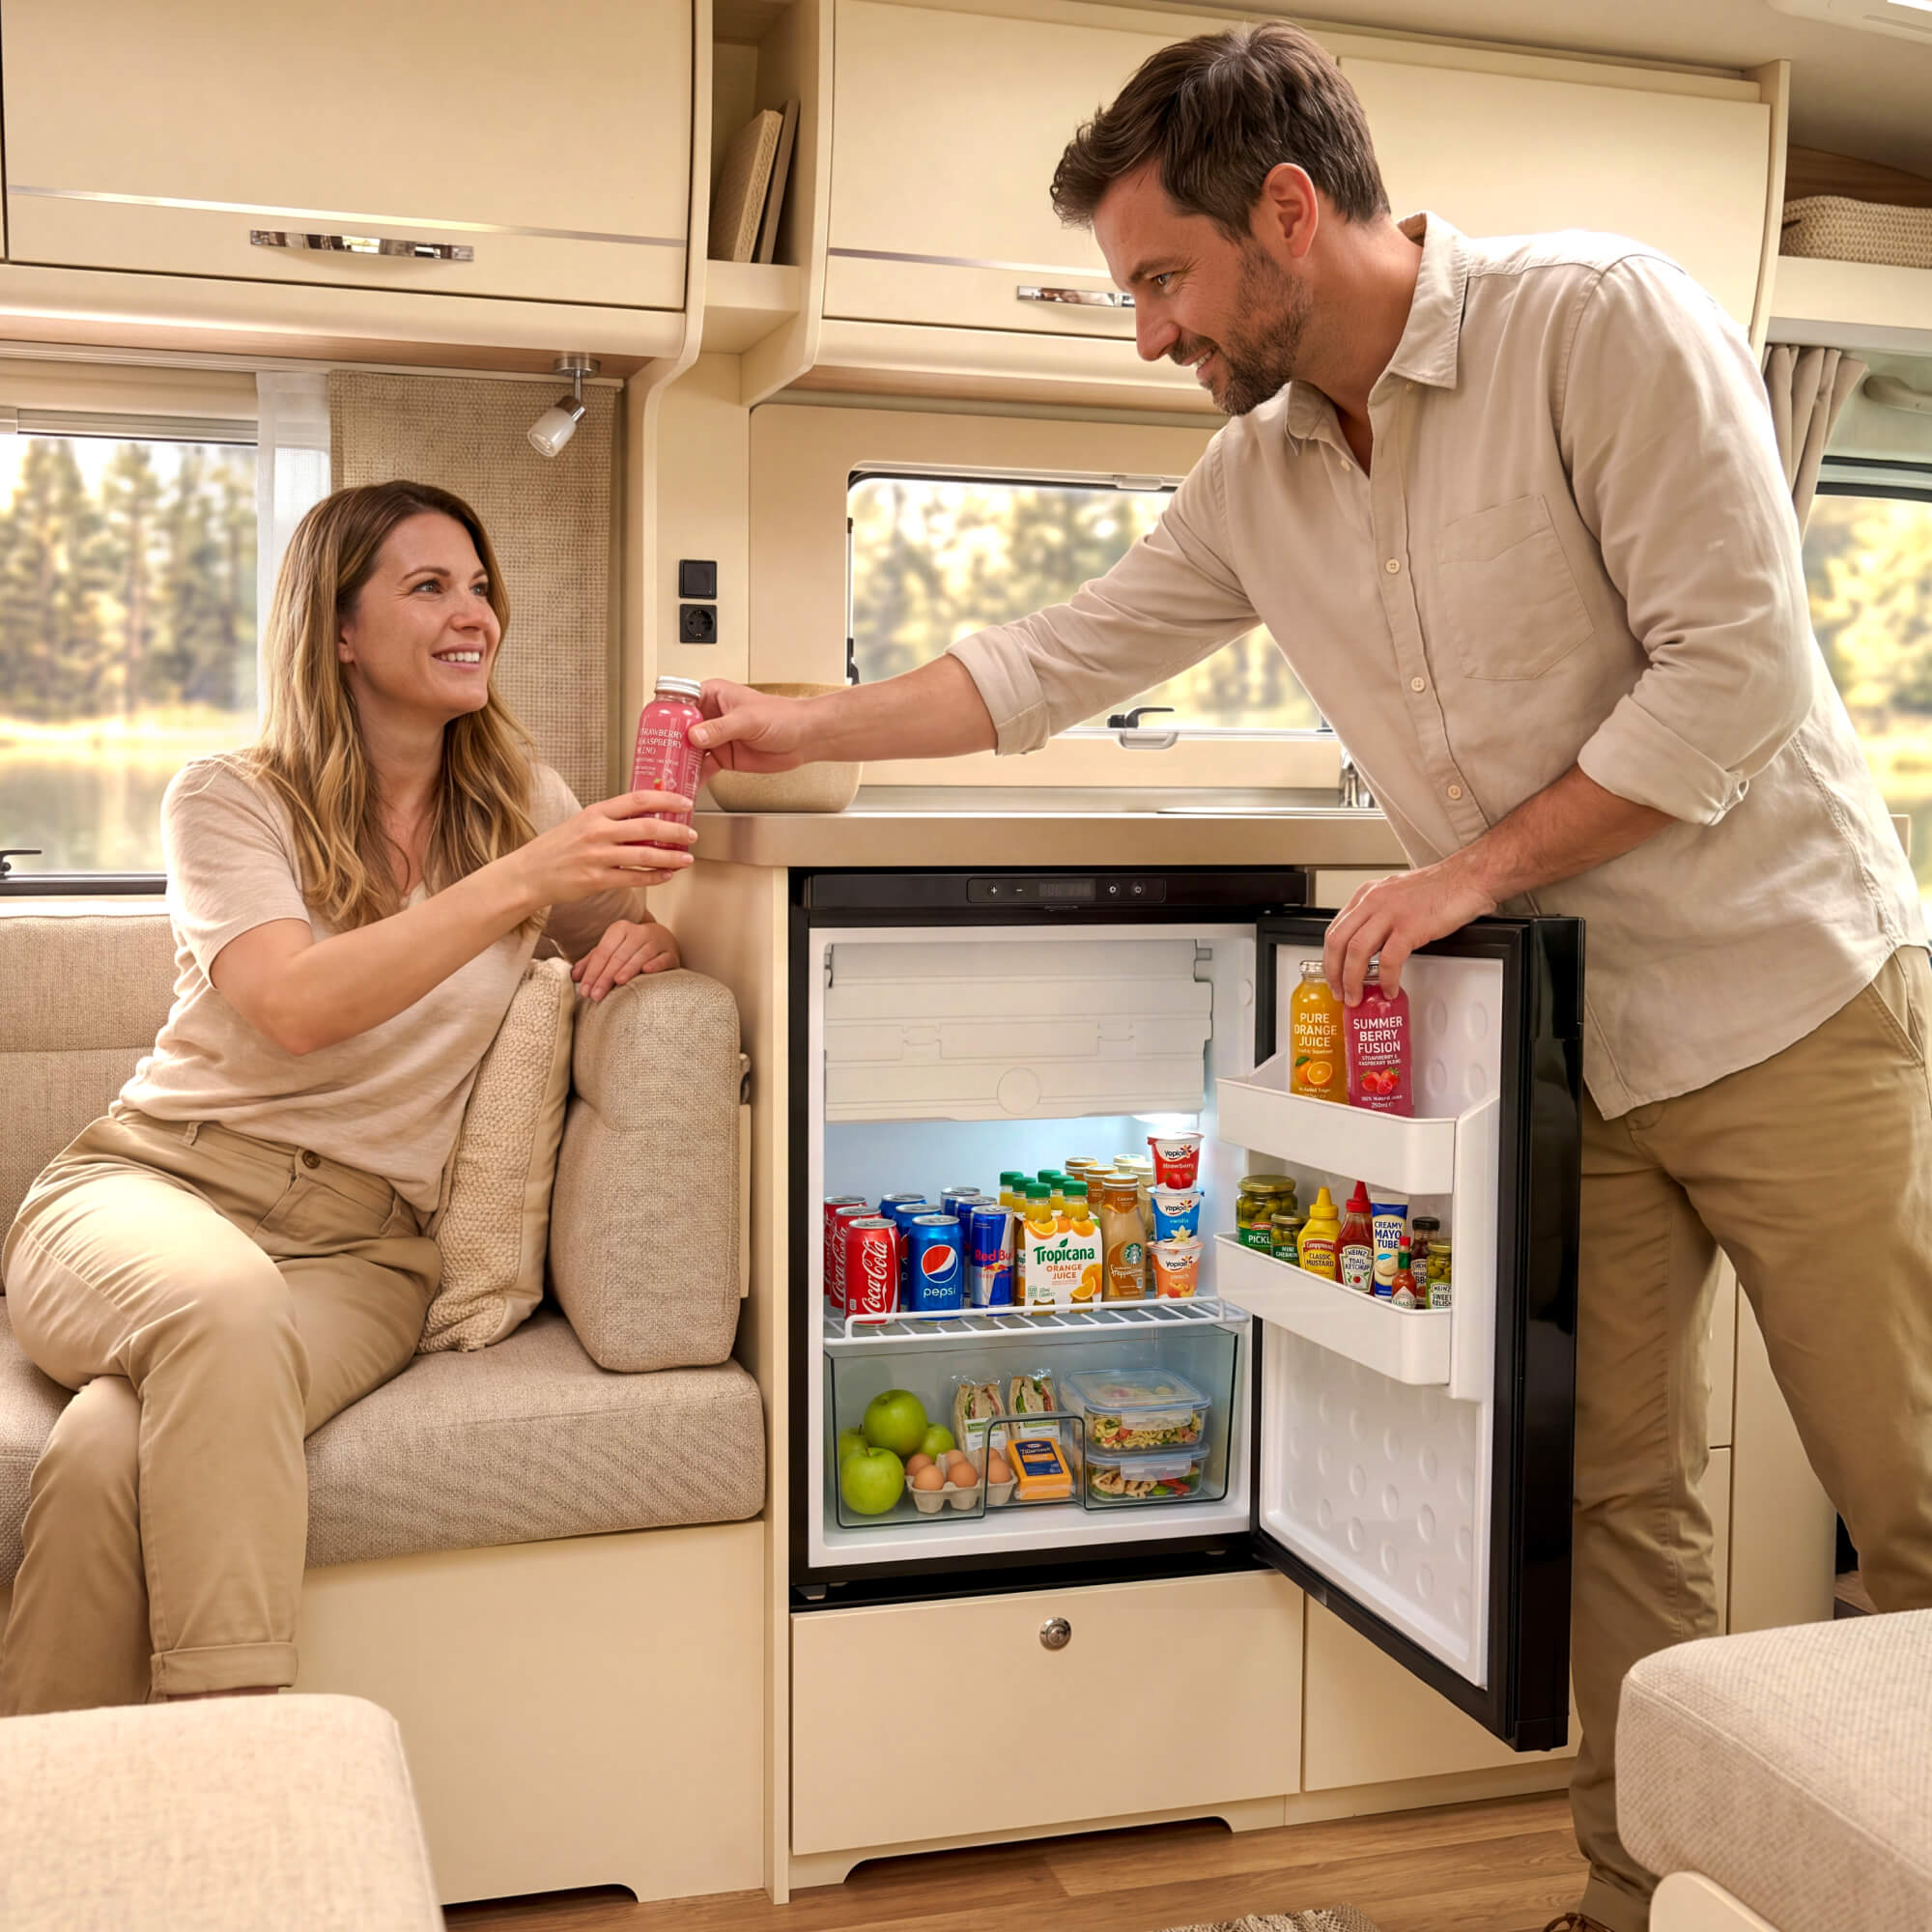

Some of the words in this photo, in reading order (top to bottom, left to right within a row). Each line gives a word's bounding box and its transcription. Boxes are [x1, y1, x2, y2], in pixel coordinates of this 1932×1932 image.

[1299, 1012, 1330, 1024] PURE
[1353, 1015, 1404, 1030] SUMMER
[1293, 1024, 1338, 1036] ORANGE
[1359, 1029, 1398, 1042] BERRY
[1298, 1036, 1331, 1047] JUICE
[1357, 1040, 1401, 1054] FUSION
[1374, 1220, 1403, 1229] CREAMY
[1248, 1235, 1270, 1244] PICKL
[1375, 1229, 1403, 1239] MAYO
[1377, 1239, 1399, 1249] TUBE
[975, 1248, 997, 1262] Red
[1033, 1246, 1095, 1264] Tropicana
[1046, 1264, 1083, 1272] ORANGE
[1306, 1259, 1335, 1267] MUSTARD
[1051, 1271, 1077, 1280] JUICE
[923, 1284, 956, 1298] pepsi
